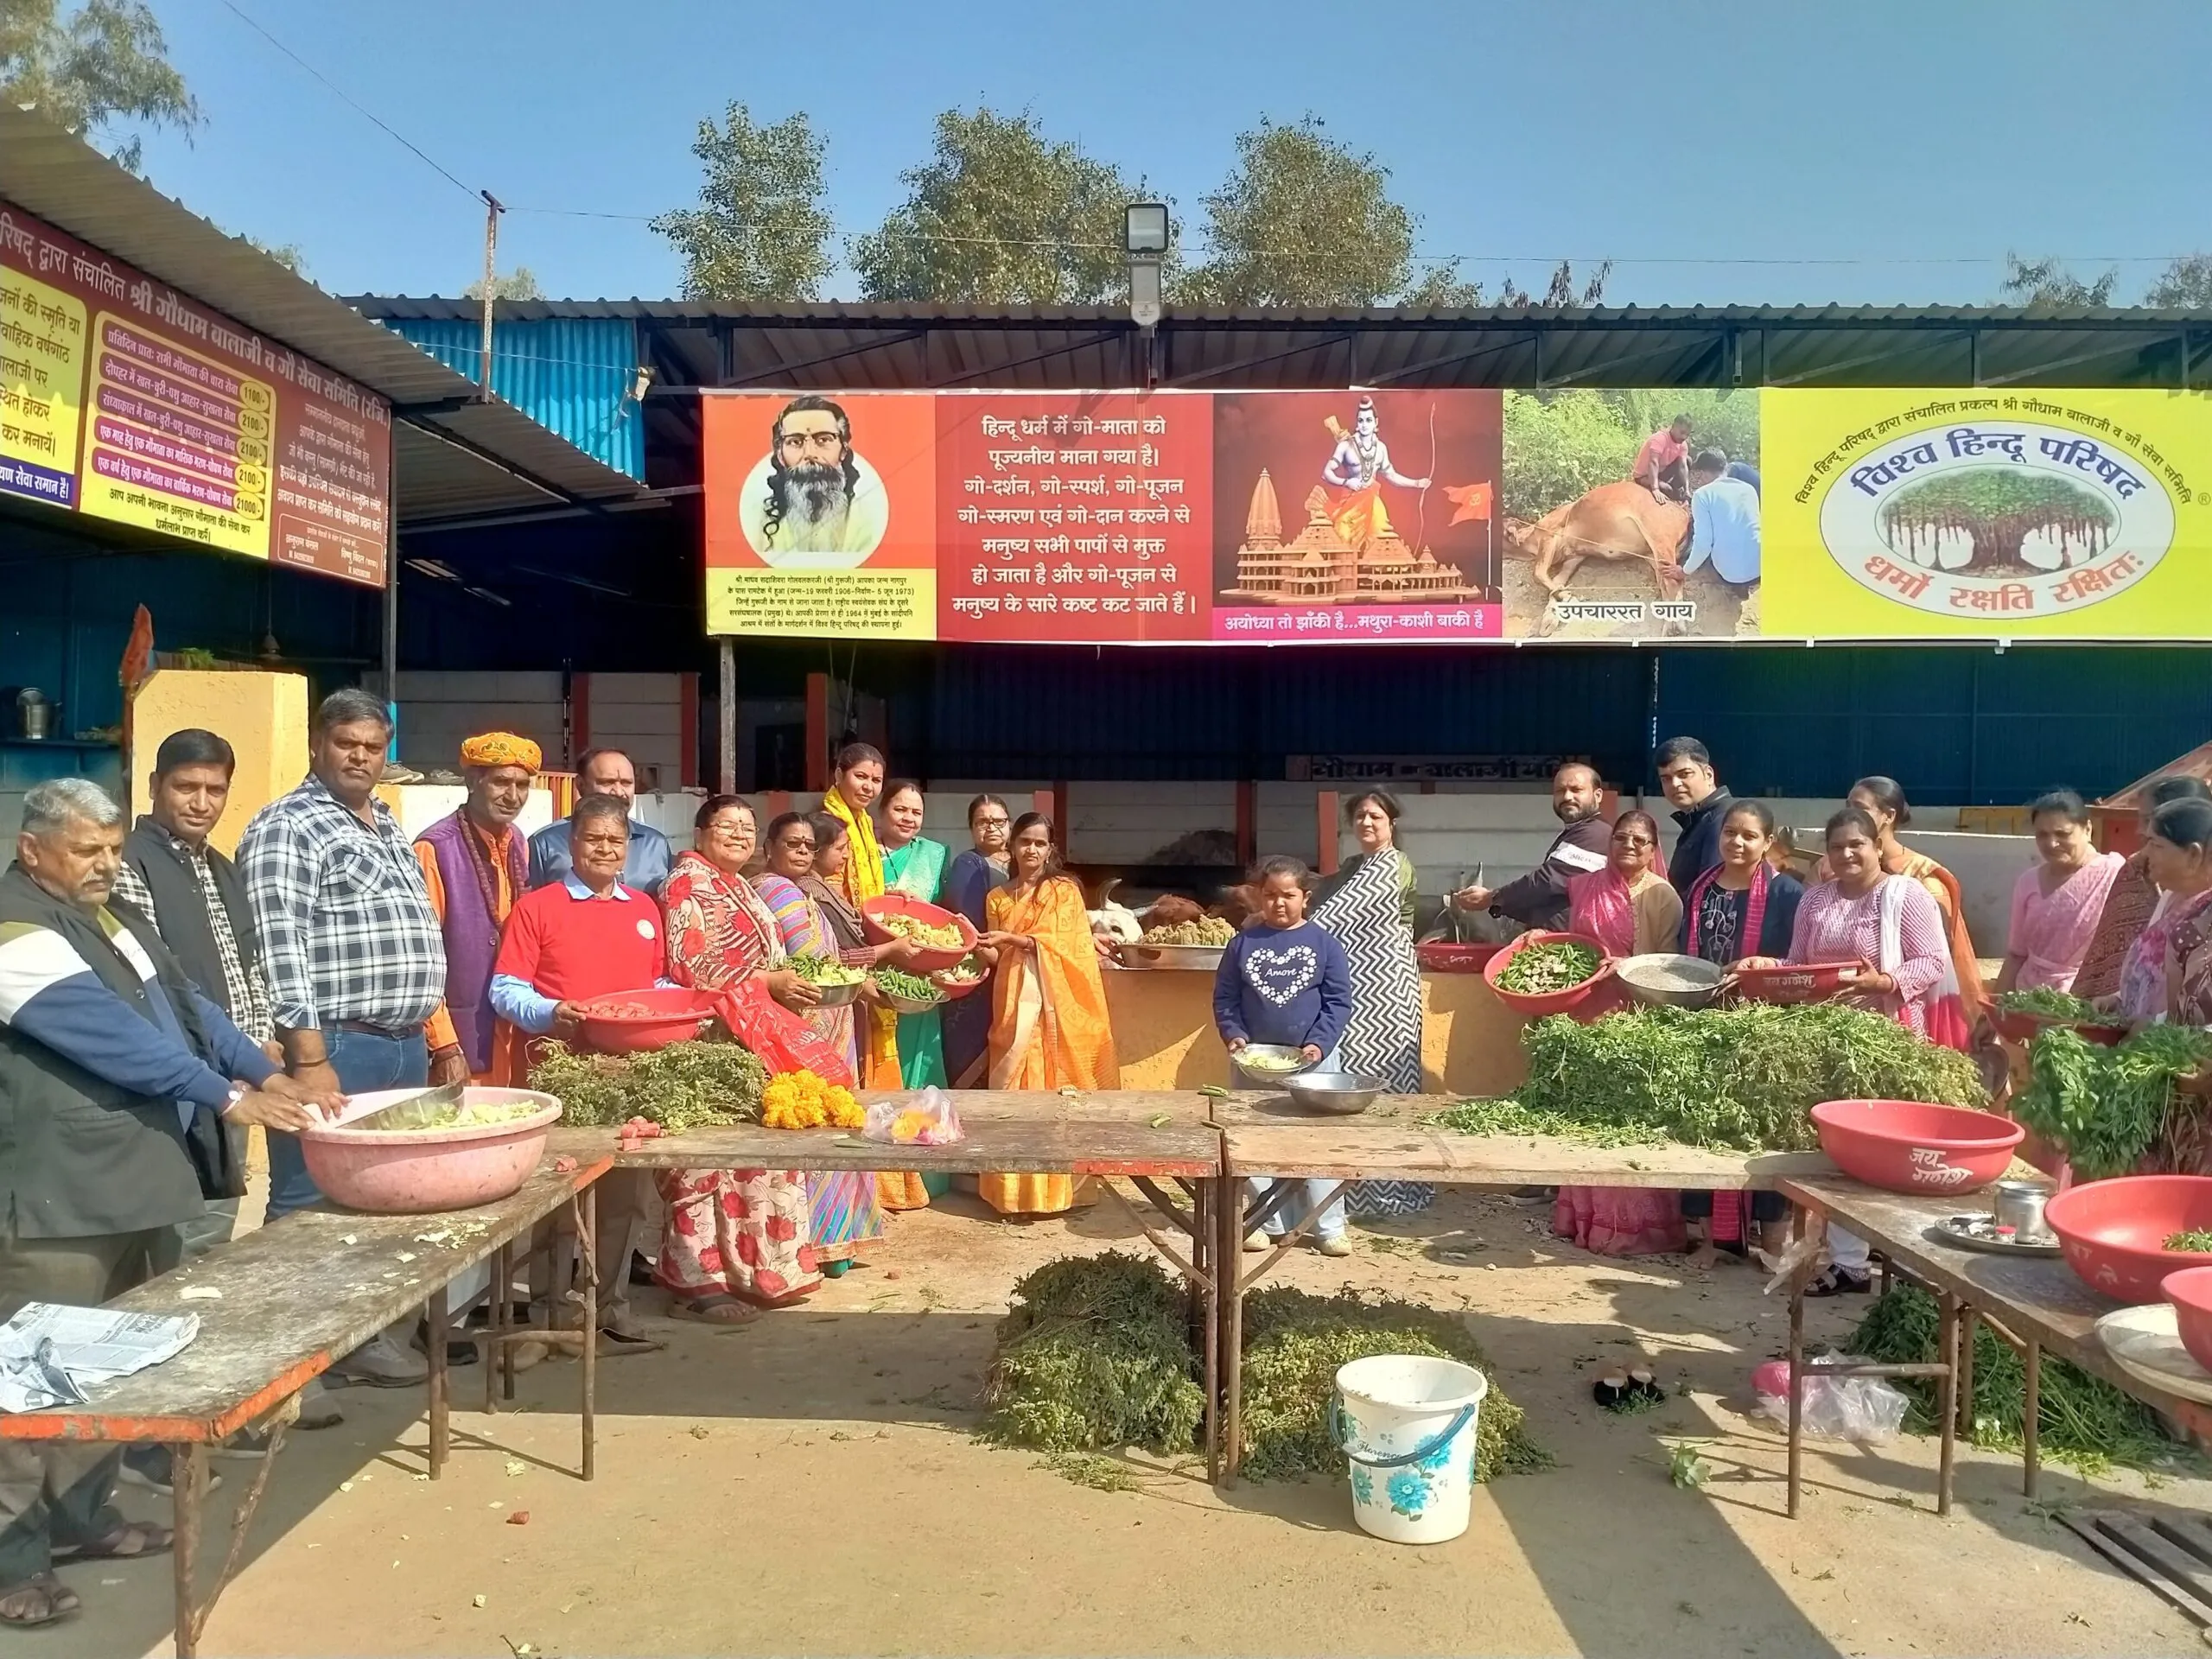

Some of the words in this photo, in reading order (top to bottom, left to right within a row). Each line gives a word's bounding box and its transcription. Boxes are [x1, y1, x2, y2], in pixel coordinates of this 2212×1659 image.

[0, 212, 35, 269] रिषद्
[39, 239, 69, 274] द्वारा
[73, 251, 126, 302] संचालित
[130, 280, 154, 315] श्री
[156, 290, 208, 340] गौधाम
[264, 349, 276, 372] व
[277, 351, 296, 382] गौ
[297, 359, 322, 395] सेवा
[324, 377, 359, 412] समिति
[22, 293, 38, 318] की
[41, 305, 67, 334] स्मृति
[68, 316, 80, 335] या
[0, 321, 34, 348] वाहिक
[0, 355, 31, 382] ालाजी
[35, 368, 48, 387] पर
[22, 393, 50, 421] होकर
[2, 423, 20, 445] कर
[982, 415, 1023, 442] हिन्दू
[1020, 415, 1048, 435] धर्म
[1052, 415, 1068, 435] में
[1072, 416, 1138, 435] गो-माता
[1142, 415, 1166, 435] को
[988, 446, 1056, 472] पूज्यनीय
[1059, 450, 1098, 465] माना
[1103, 450, 1136, 465] गया
[1795, 474, 1820, 504] विश्व
[1814, 449, 1847, 475] हिन्दू
[1839, 427, 1878, 452] परिषद्
[1875, 415, 1901, 435] द्वारा
[1904, 401, 1956, 422] संचालित
[1960, 398, 1999, 411] प्रकल्प
[2003, 397, 2018, 410] श्री
[2022, 398, 2063, 416] गौधाम
[2067, 408, 2110, 432] बालाजी
[2113, 426, 2122, 438] व
[2125, 433, 2142, 448] गौ
[2142, 443, 2164, 467] सेवा
[2164, 462, 2192, 505] समिति
[1850, 442, 1939, 498] विश्व
[1946, 428, 2026, 463] हिन्दू
[2040, 439, 2146, 500] परिषद
[16, 465, 33, 488] सेवा
[35, 475, 59, 494] समान
[1115, 475, 1184, 500] गो-पूजन
[109, 487, 124, 501] आप
[126, 493, 146, 507] अपनी
[148, 497, 169, 513] भावना
[170, 505, 194, 522] अनुसार
[218, 514, 227, 530] की
[240, 524, 251, 536] कर
[957, 505, 1035, 524] गो-स्मरण
[1039, 504, 1063, 528] एवं
[1066, 505, 1124, 525] गो-दान
[1128, 505, 1169, 524] करने
[1173, 504, 1191, 524] से
[982, 538, 1030, 561] मनुष्य
[1033, 534, 1070, 554] सभी
[1074, 533, 1108, 554] पापों
[1111, 534, 1128, 553] से
[1133, 538, 1166, 560] मुक्त
[971, 563, 988, 586] हो
[992, 569, 1031, 584] जाता
[1034, 562, 1046, 586] है
[1052, 563, 1084, 584] और
[1088, 563, 1156, 589] गो-पूजन
[1160, 563, 1177, 582] से
[951, 597, 1000, 620] मनुष्य
[1003, 593, 1022, 613] के
[1027, 593, 1058, 613] सारे
[1062, 598, 1097, 613] कष्ट
[1101, 598, 1131, 613] कट
[1135, 593, 1168, 612] जाते
[1172, 591, 1186, 614] हैं
[1948, 583, 2035, 611] रक्षति
[1224, 613, 1274, 630] अयोध्या
[1278, 613, 1293, 629] तो
[1295, 611, 1331, 629] झाँकी
[1437, 610, 1471, 627] बाकी
[1474, 609, 1484, 629] है
[1558, 605, 1643, 620] उपचाररत
[1654, 605, 1694, 618] गाय
[1264, 968, 1298, 977] Amore
[1909, 1147, 1947, 1167] जय
